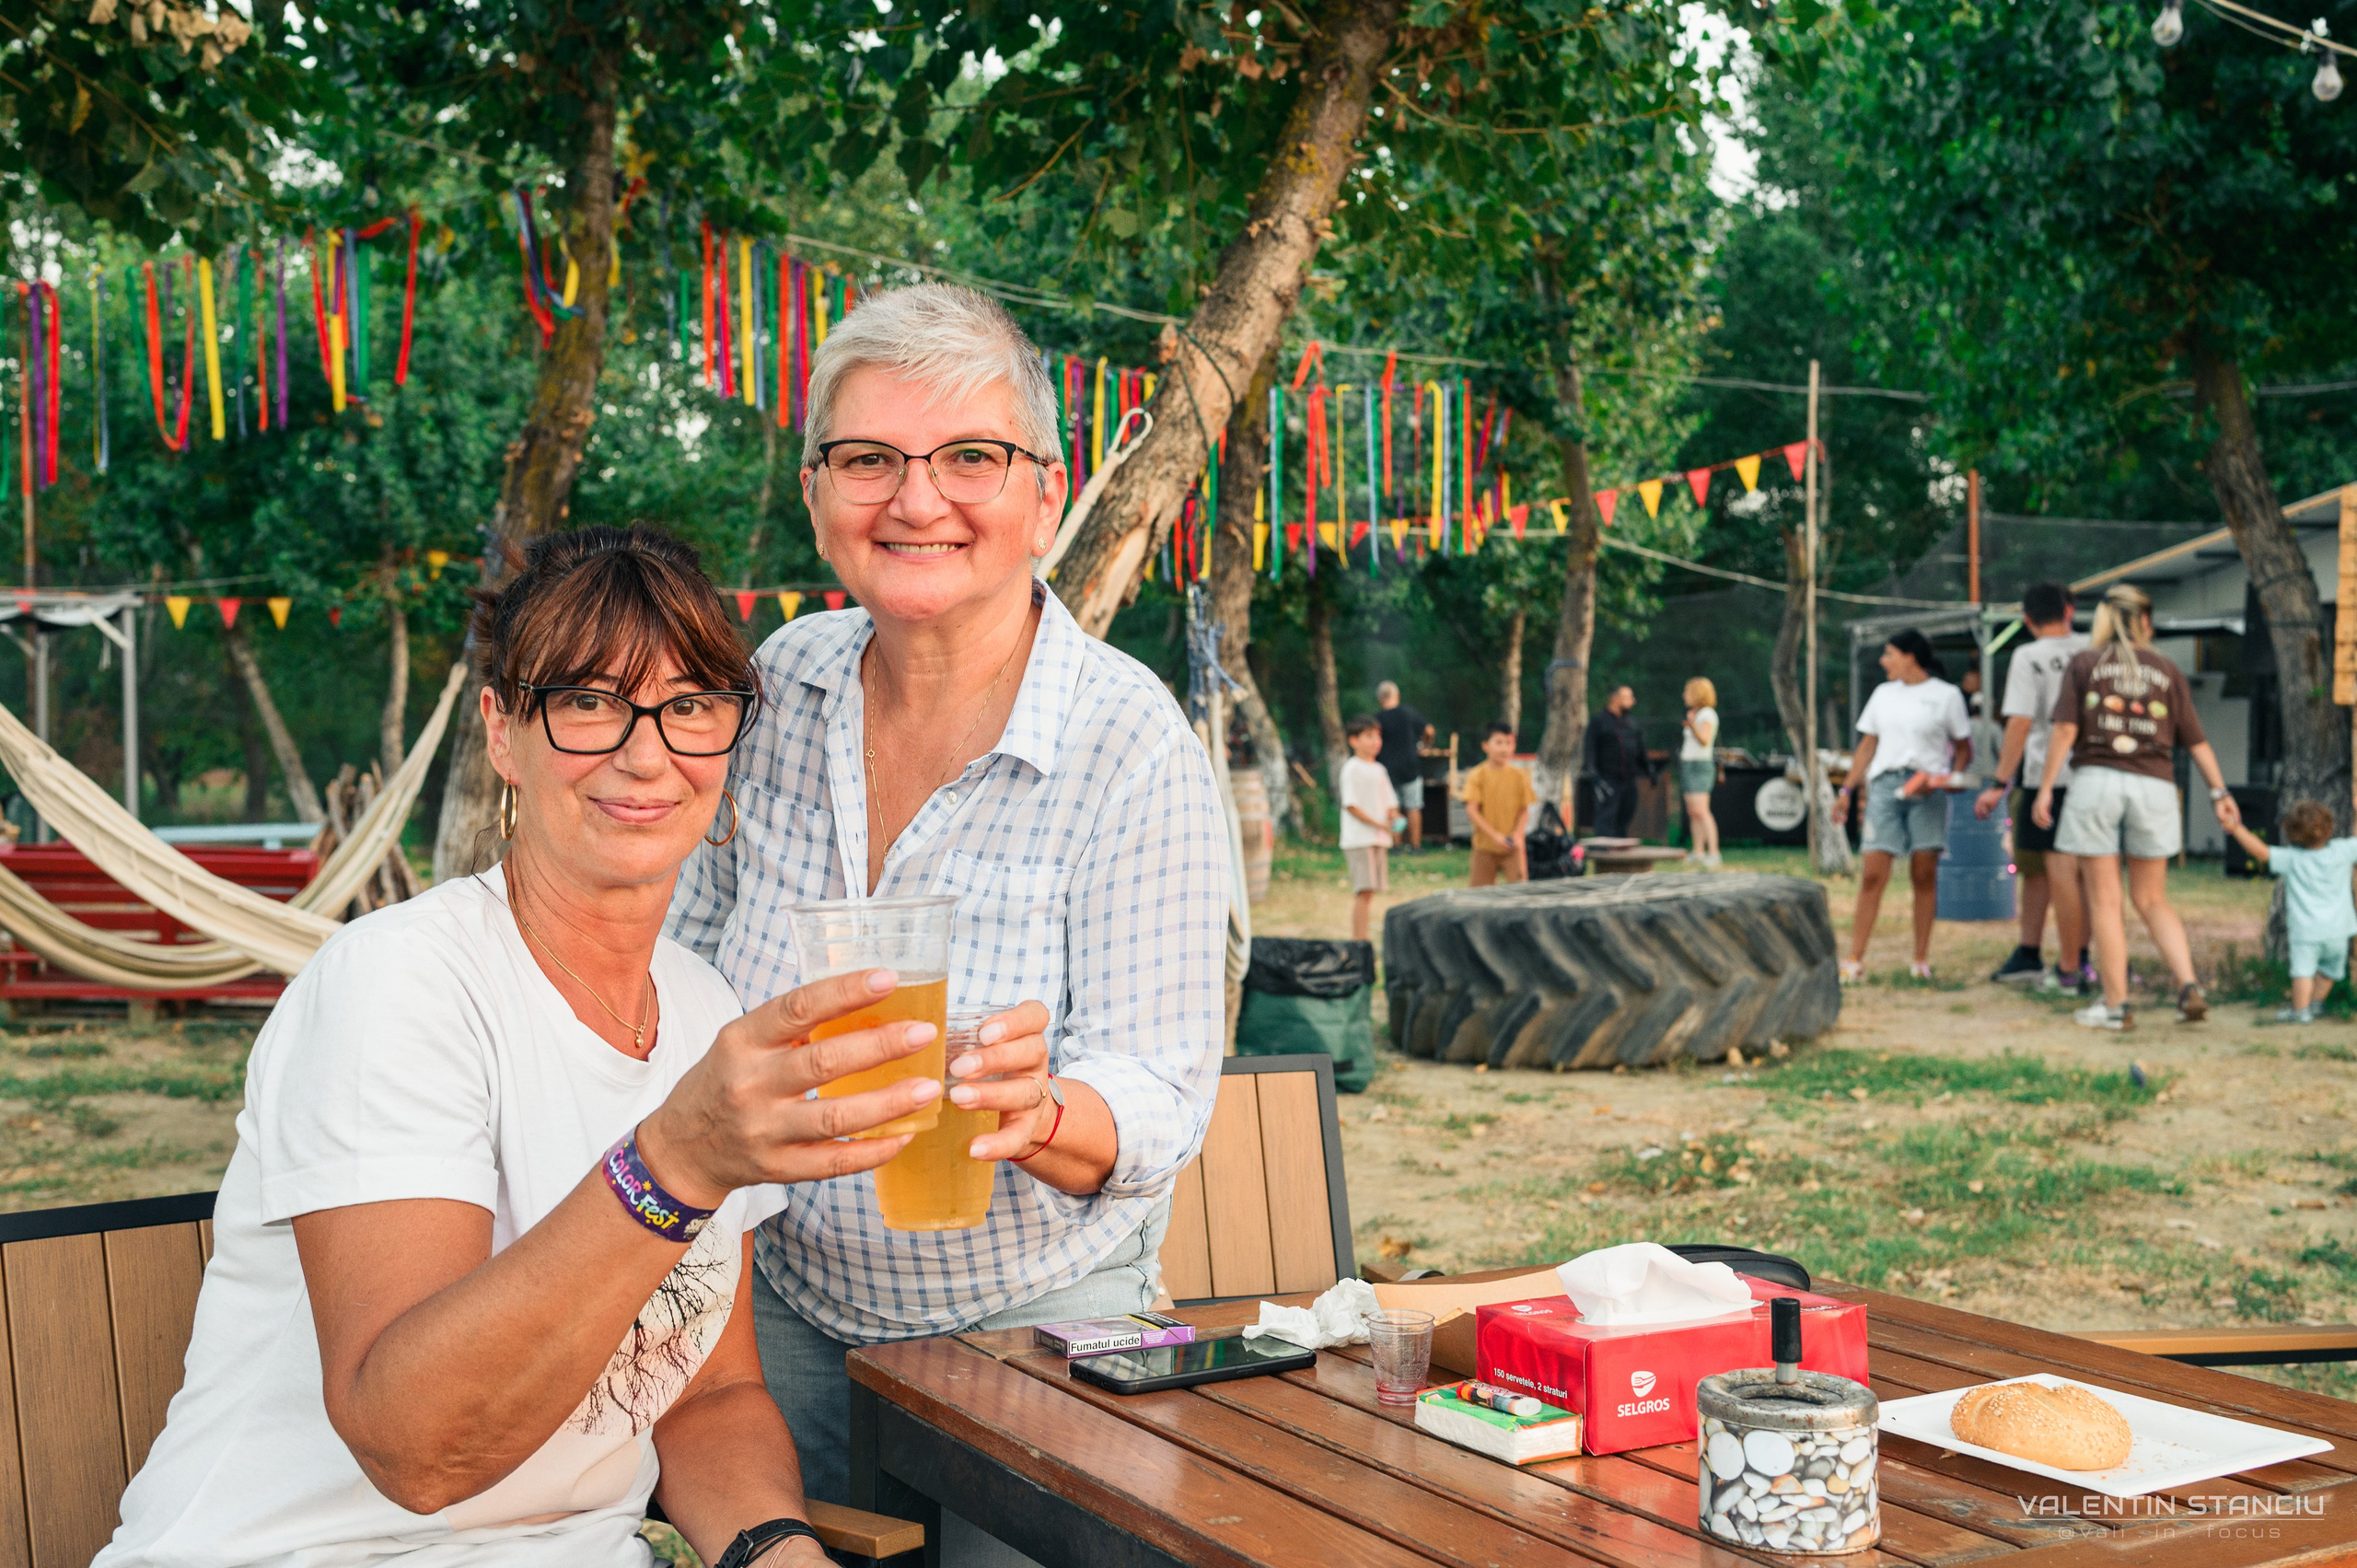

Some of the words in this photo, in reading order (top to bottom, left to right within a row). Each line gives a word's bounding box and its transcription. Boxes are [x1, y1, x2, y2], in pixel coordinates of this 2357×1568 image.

[610, 1148, 643, 1205] COLOR
[1071, 1339, 1110, 1353] Fumatul
[1113, 1336, 1140, 1347] ucide
[1493, 1367, 1505, 1379] 150
[1538, 1383, 1542, 1391] 2
[1543, 1385, 1568, 1399] straturi
[1618, 1398, 1670, 1418] SELGROS
